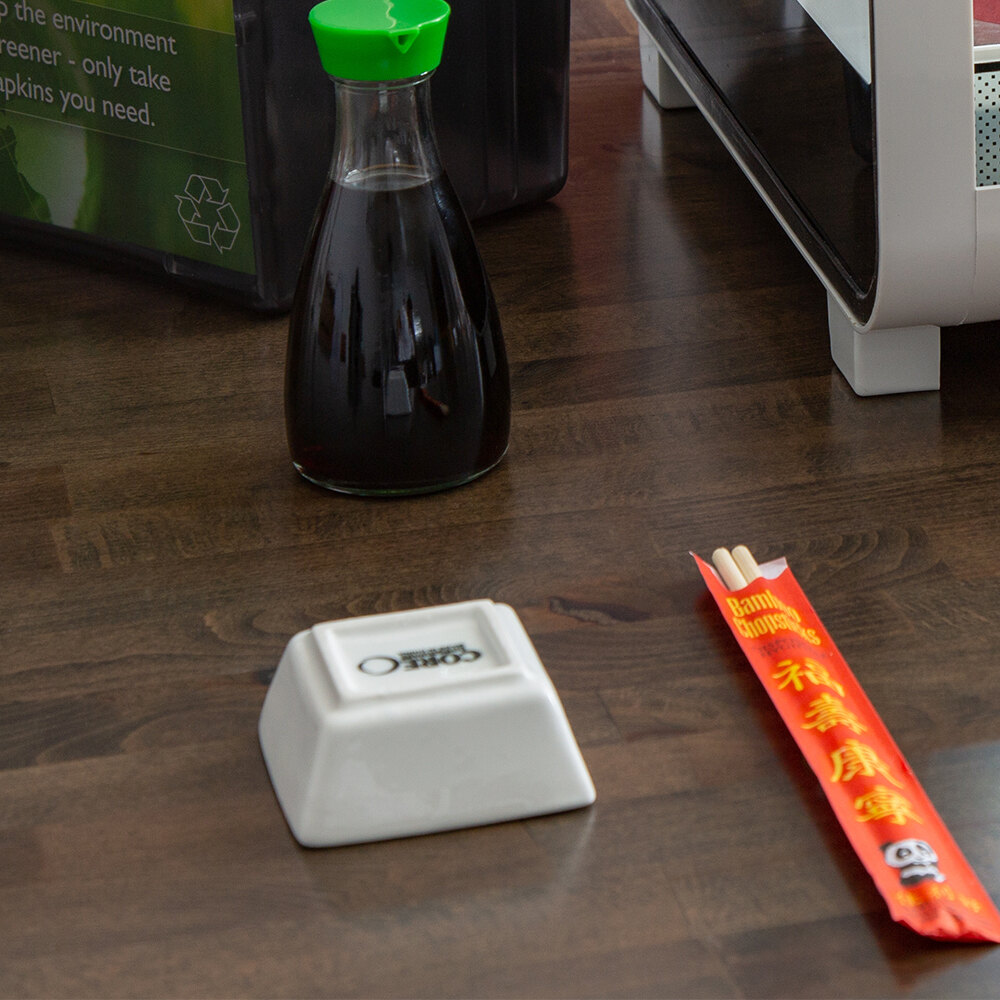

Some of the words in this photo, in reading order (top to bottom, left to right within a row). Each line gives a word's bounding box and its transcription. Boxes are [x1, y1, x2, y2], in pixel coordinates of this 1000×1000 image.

[15, 0, 46, 25] the
[53, 12, 178, 55] environment
[0, 38, 61, 66] reener
[82, 55, 123, 87] only
[129, 65, 171, 91] take
[60, 89, 96, 113] you
[102, 99, 156, 127] need.
[404, 649, 482, 671] CORE
